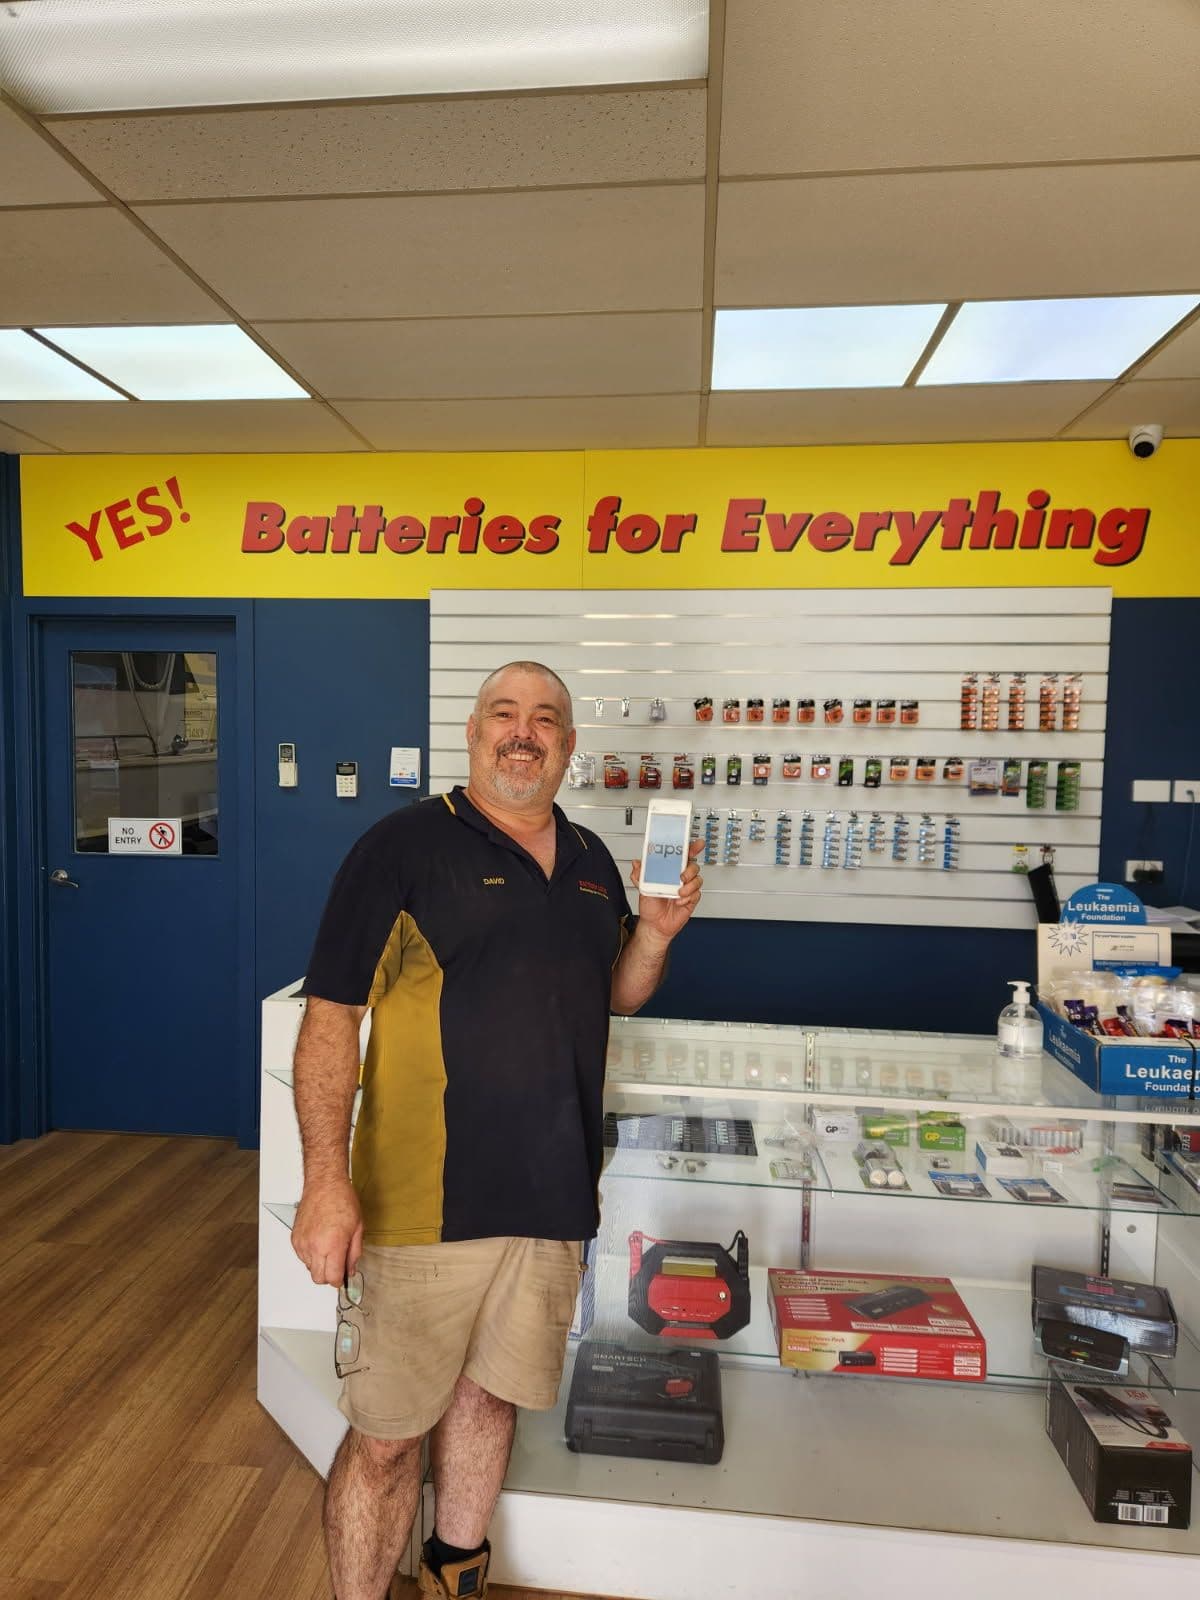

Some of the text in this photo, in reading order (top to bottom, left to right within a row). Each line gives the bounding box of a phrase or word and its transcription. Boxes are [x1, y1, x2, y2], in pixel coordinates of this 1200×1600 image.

[67, 478, 192, 562] YES!
[241, 489, 1152, 567] Batteries for Everything
[122, 827, 134, 835] NO
[483, 877, 505, 885] DAVID
[1067, 901, 1140, 913] Leukaemia
[1081, 913, 1126, 922] Foundation
[1168, 1055, 1187, 1064] The
[826, 1125, 838, 1133] GP
